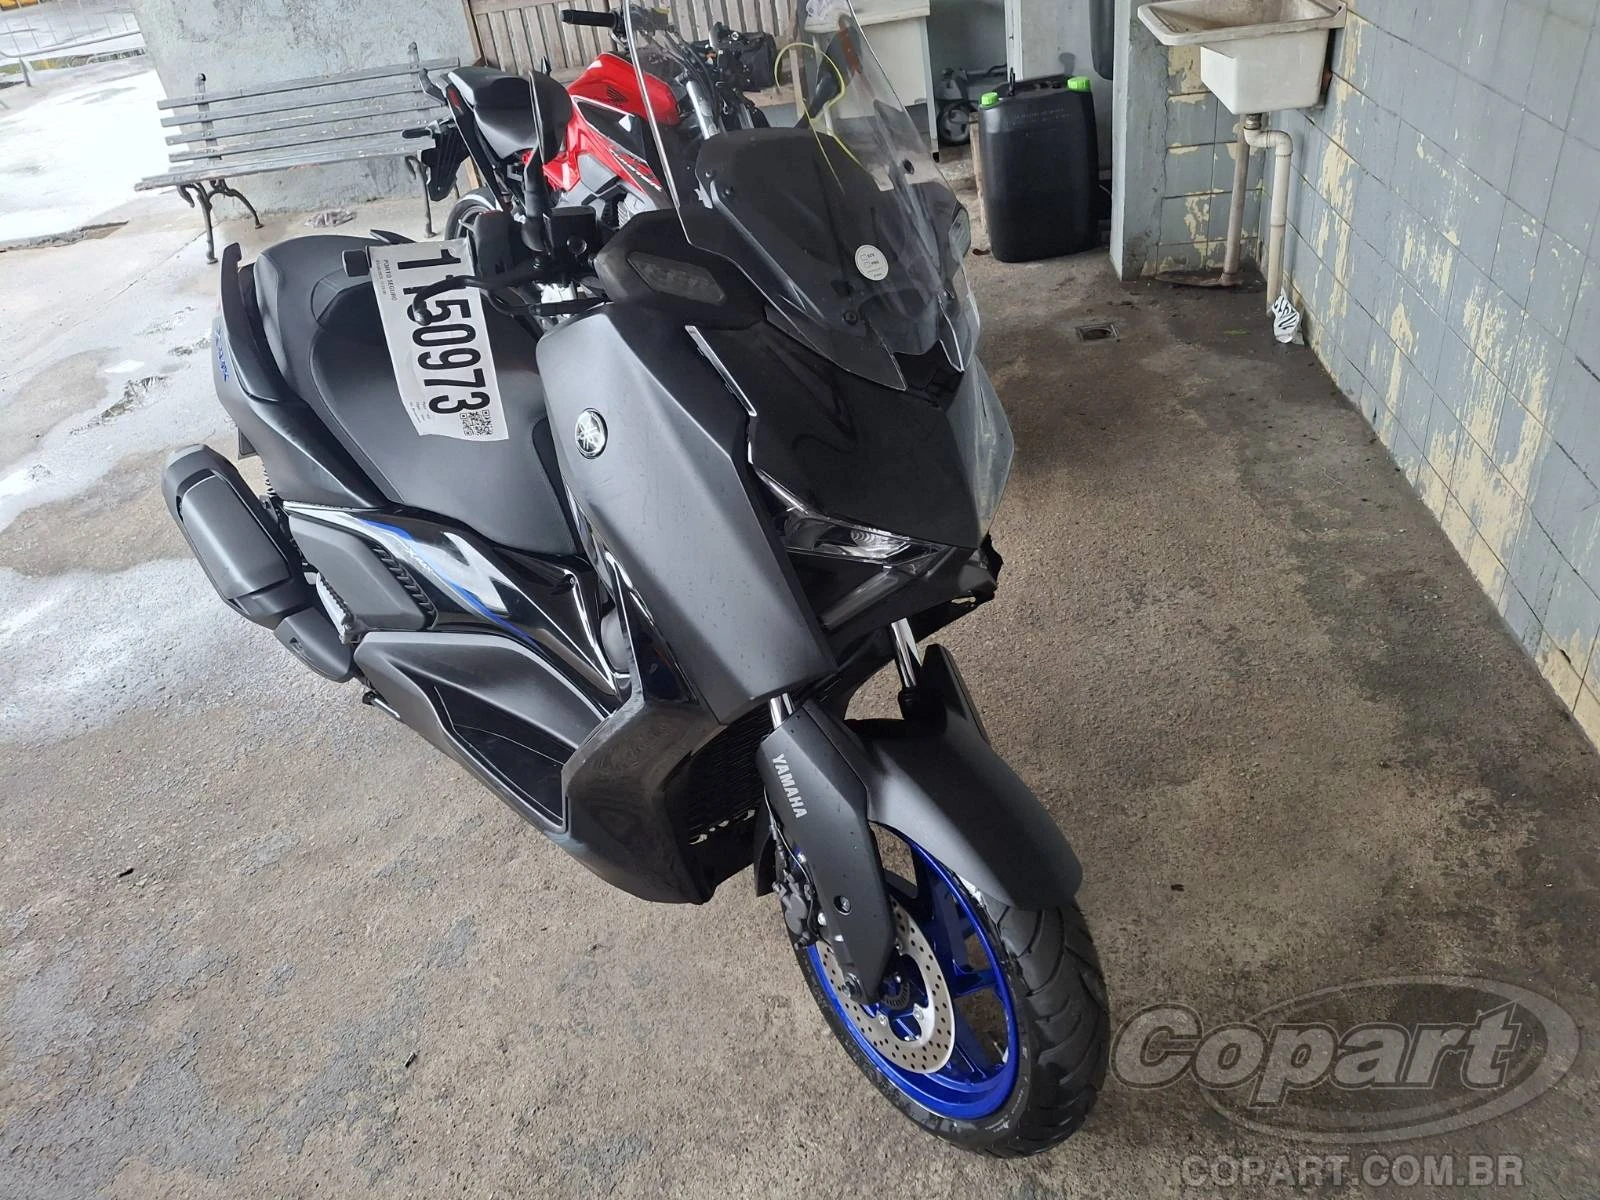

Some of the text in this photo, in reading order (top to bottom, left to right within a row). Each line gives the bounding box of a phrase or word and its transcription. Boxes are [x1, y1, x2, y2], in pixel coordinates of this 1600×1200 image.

[383, 259, 398, 301] PORTO SEGURO
[772, 753, 808, 818] YAMAHA
